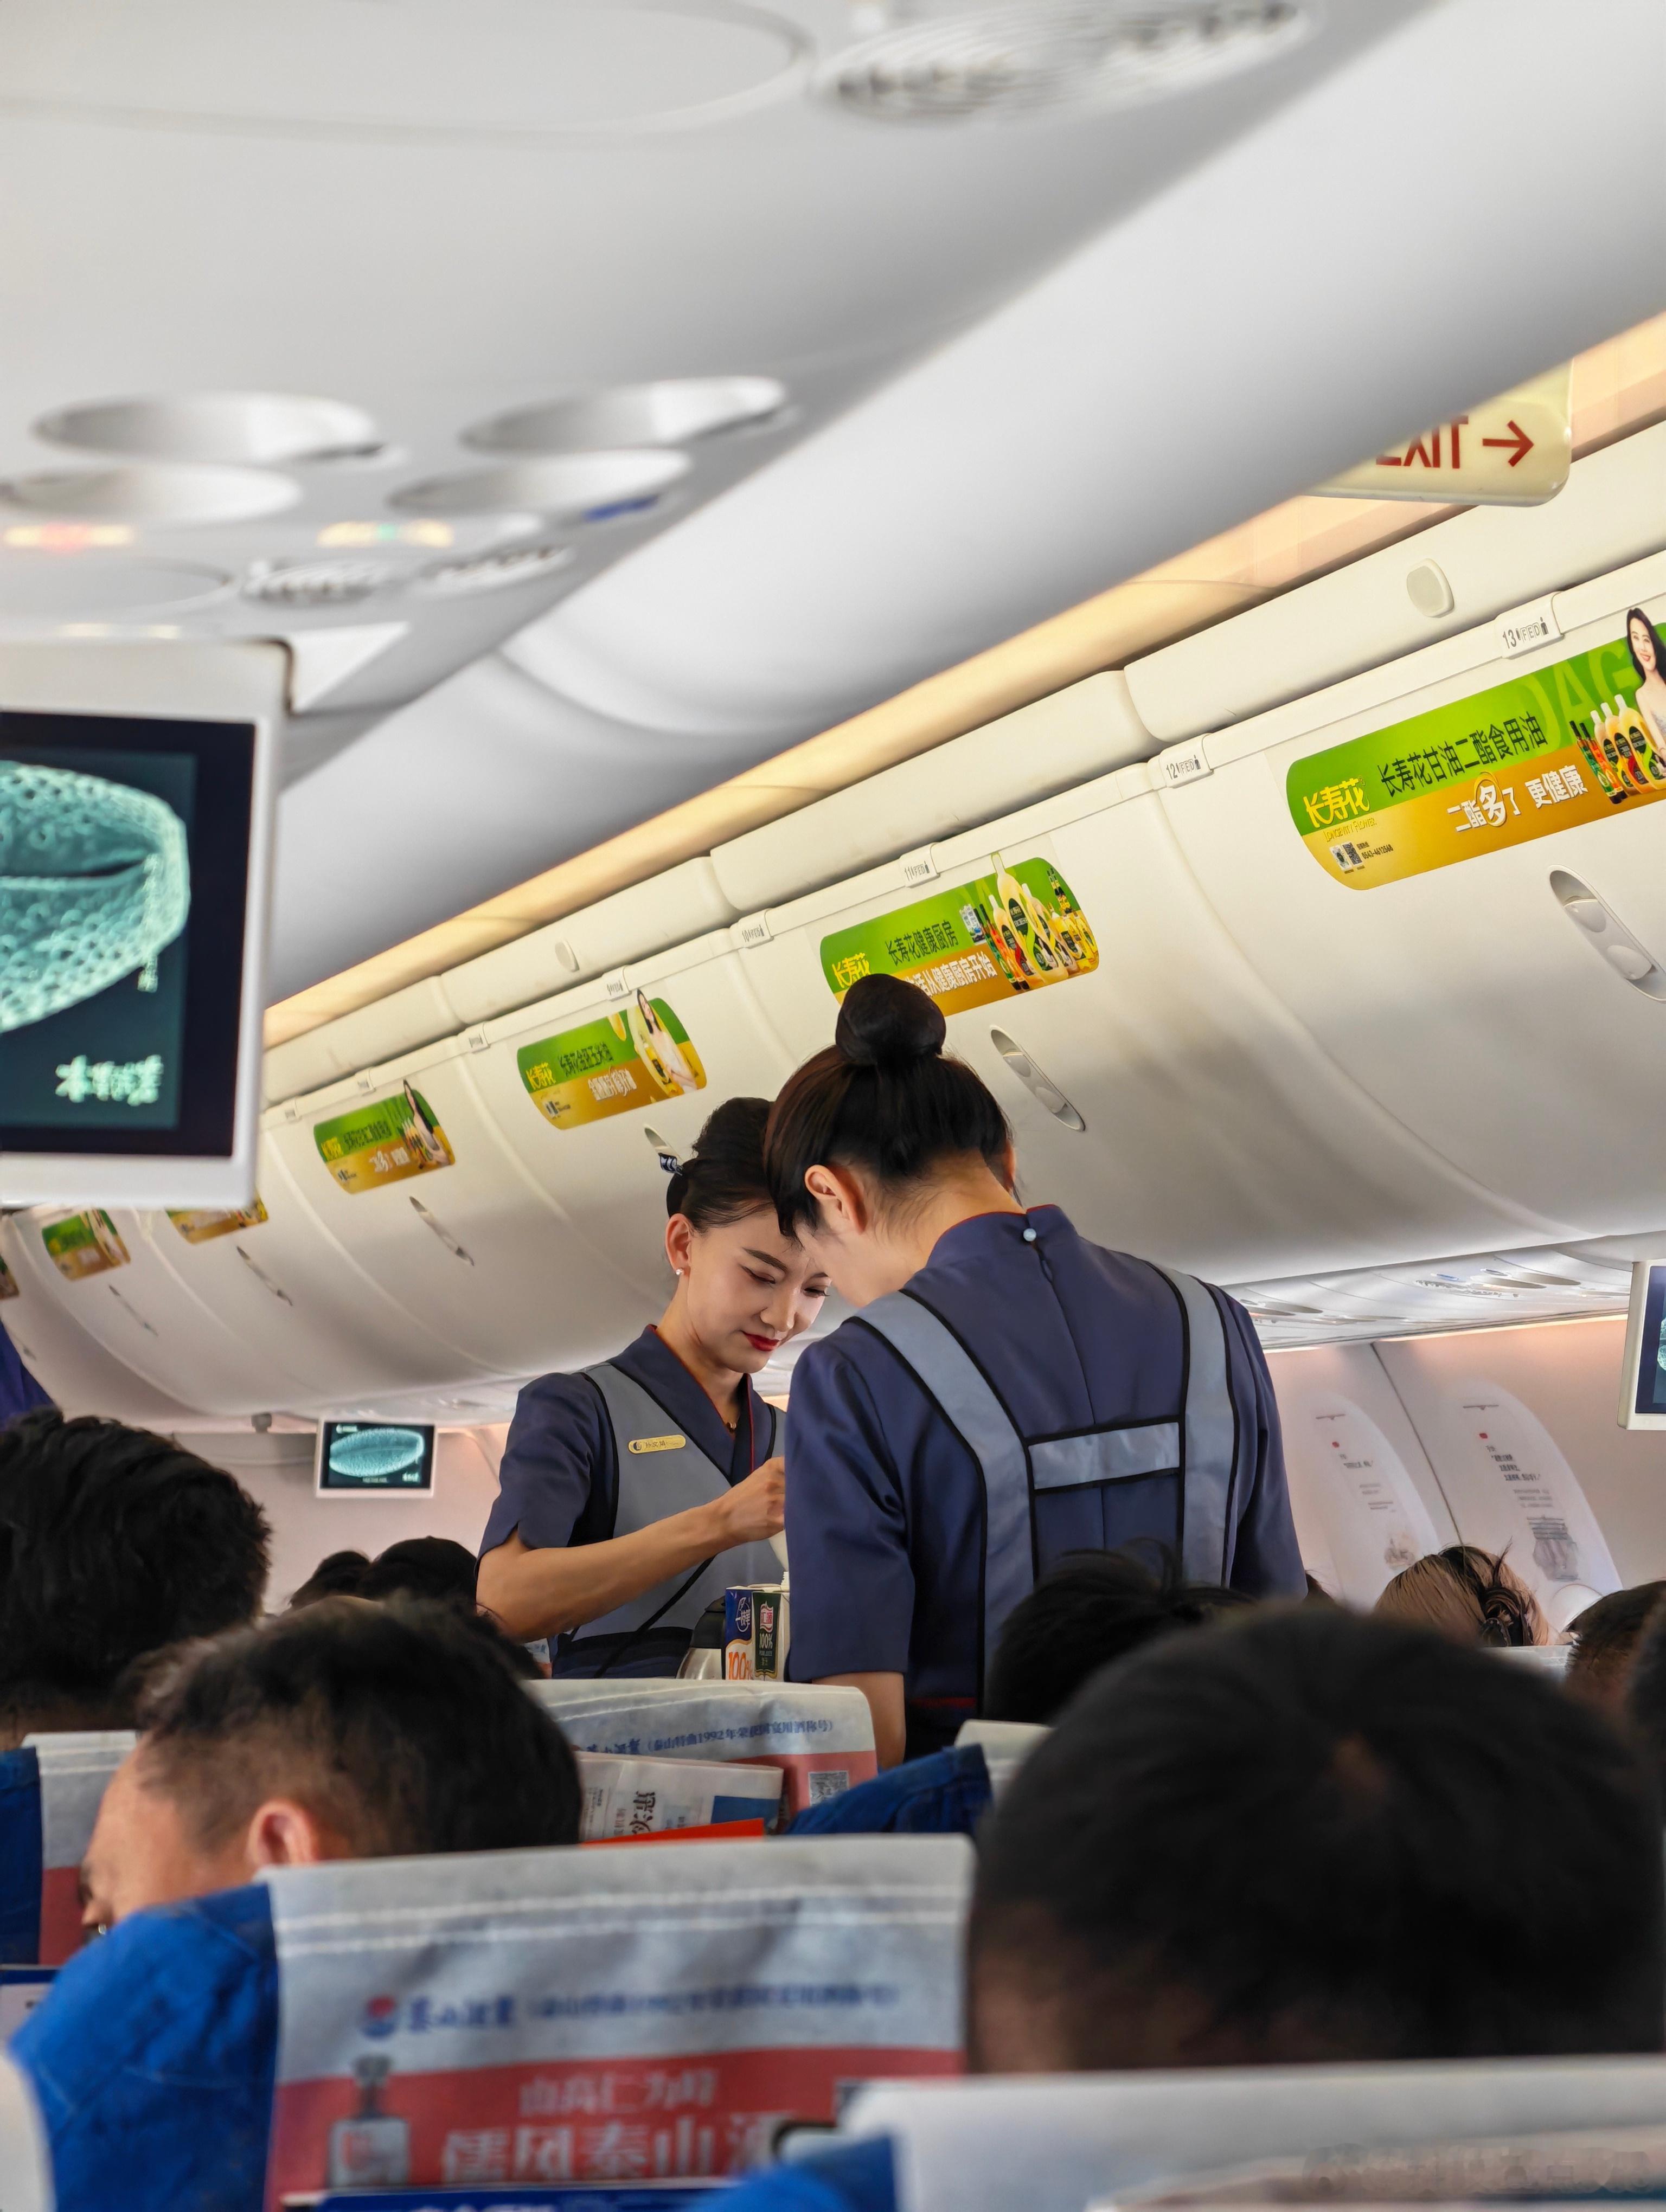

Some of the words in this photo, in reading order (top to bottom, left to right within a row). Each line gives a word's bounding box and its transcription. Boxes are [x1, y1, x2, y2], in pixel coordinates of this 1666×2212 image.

[1502, 629, 1517, 649] 13
[1166, 763, 1178, 780] 12
[1377, 711, 1548, 797] 长寿花甘油二酯食用油
[1303, 778, 1370, 828] 长寿花
[1447, 784, 1521, 833] 二酯多了
[1524, 764, 1588, 809] 更健康
[885, 919, 959, 967] 长寿花健康厨房
[905, 950, 998, 998] 活从健康厨房开始
[759, 1633, 773, 1649] 100%
